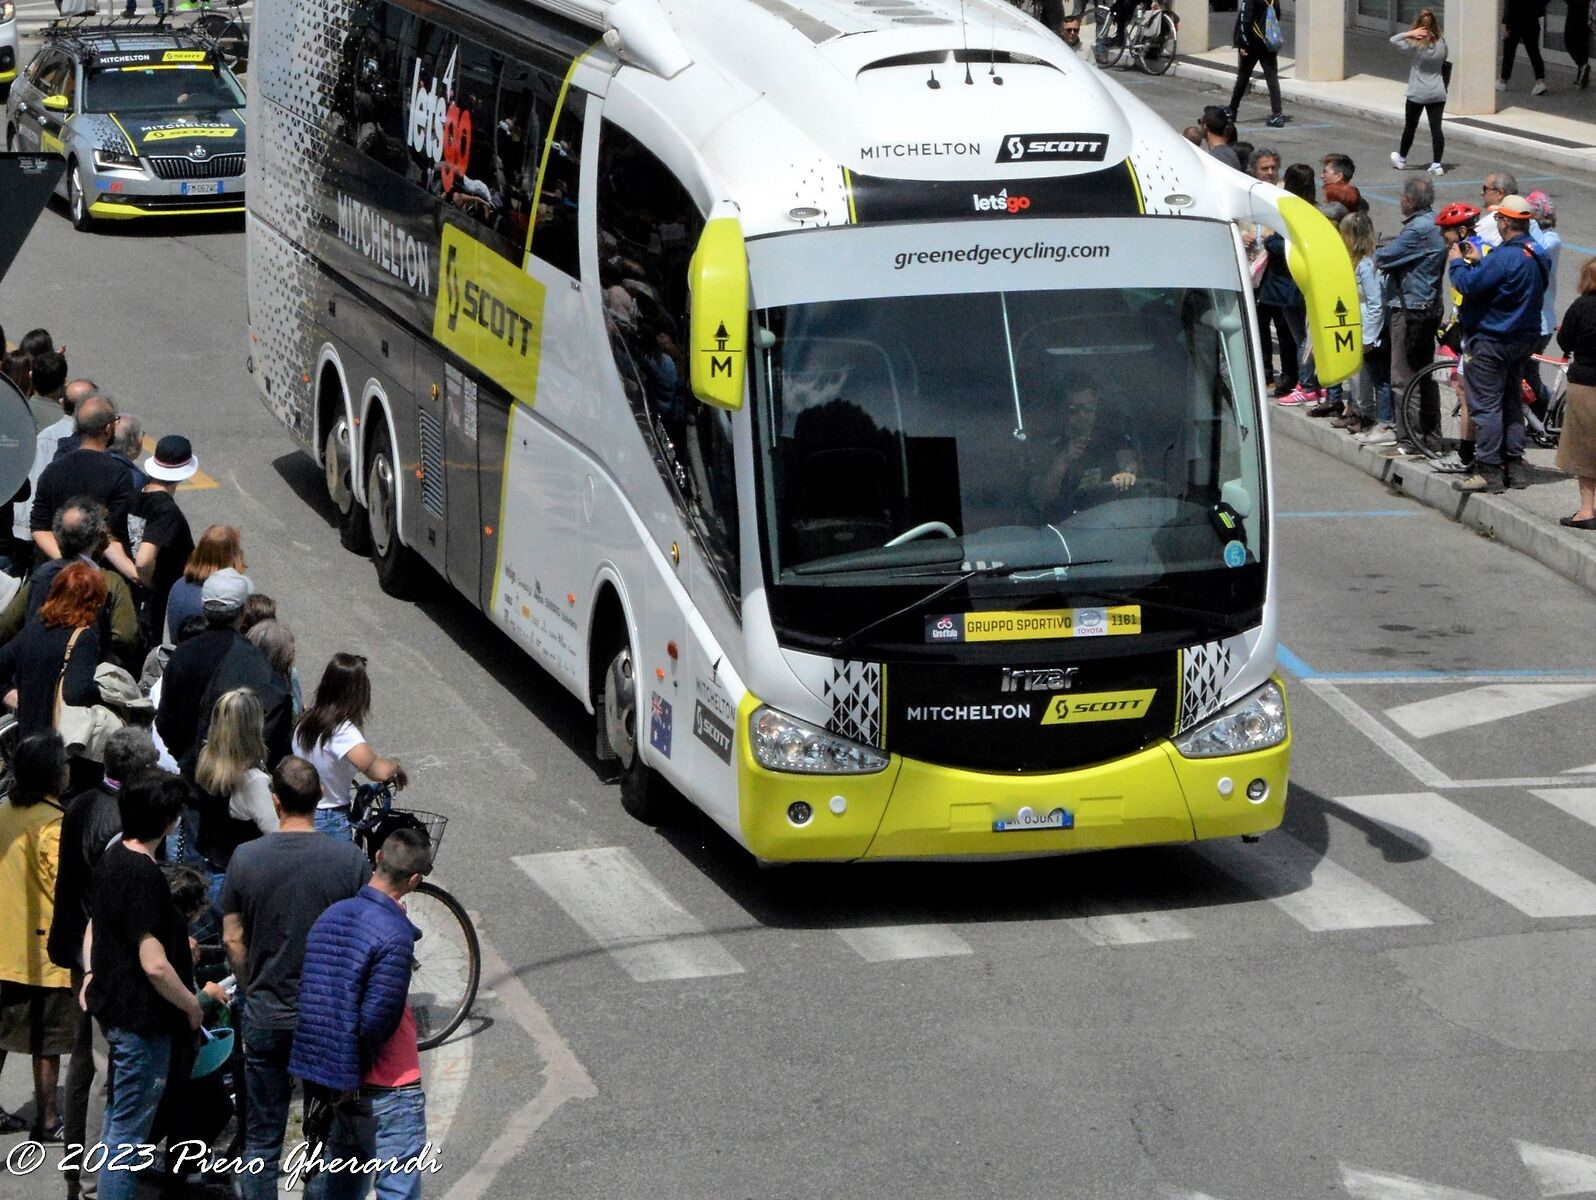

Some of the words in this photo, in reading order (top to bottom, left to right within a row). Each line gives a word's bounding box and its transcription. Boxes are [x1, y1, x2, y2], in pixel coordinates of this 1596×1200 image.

[100, 54, 151, 64] MITCHELTON
[141, 122, 231, 132] MITCHELTON
[860, 141, 981, 161] MITCHELTON
[1025, 139, 1102, 155] SCOTT
[894, 240, 1111, 270] greenedgecycling.com
[337, 190, 430, 296] MITCHELTON
[462, 278, 533, 358] SCOTT
[1335, 330, 1355, 353] M
[709, 355, 732, 378] M
[967, 618, 1014, 633] GRUPPO
[1017, 616, 1072, 631] SPORTIVO
[1111, 613, 1137, 626] 1161
[1077, 627, 1104, 635] TOYOTA
[695, 678, 736, 722] MITCHELTON
[906, 702, 1031, 722] MITCHELTON
[1072, 698, 1145, 714] SCOTT
[702, 719, 731, 750] SCOTT
